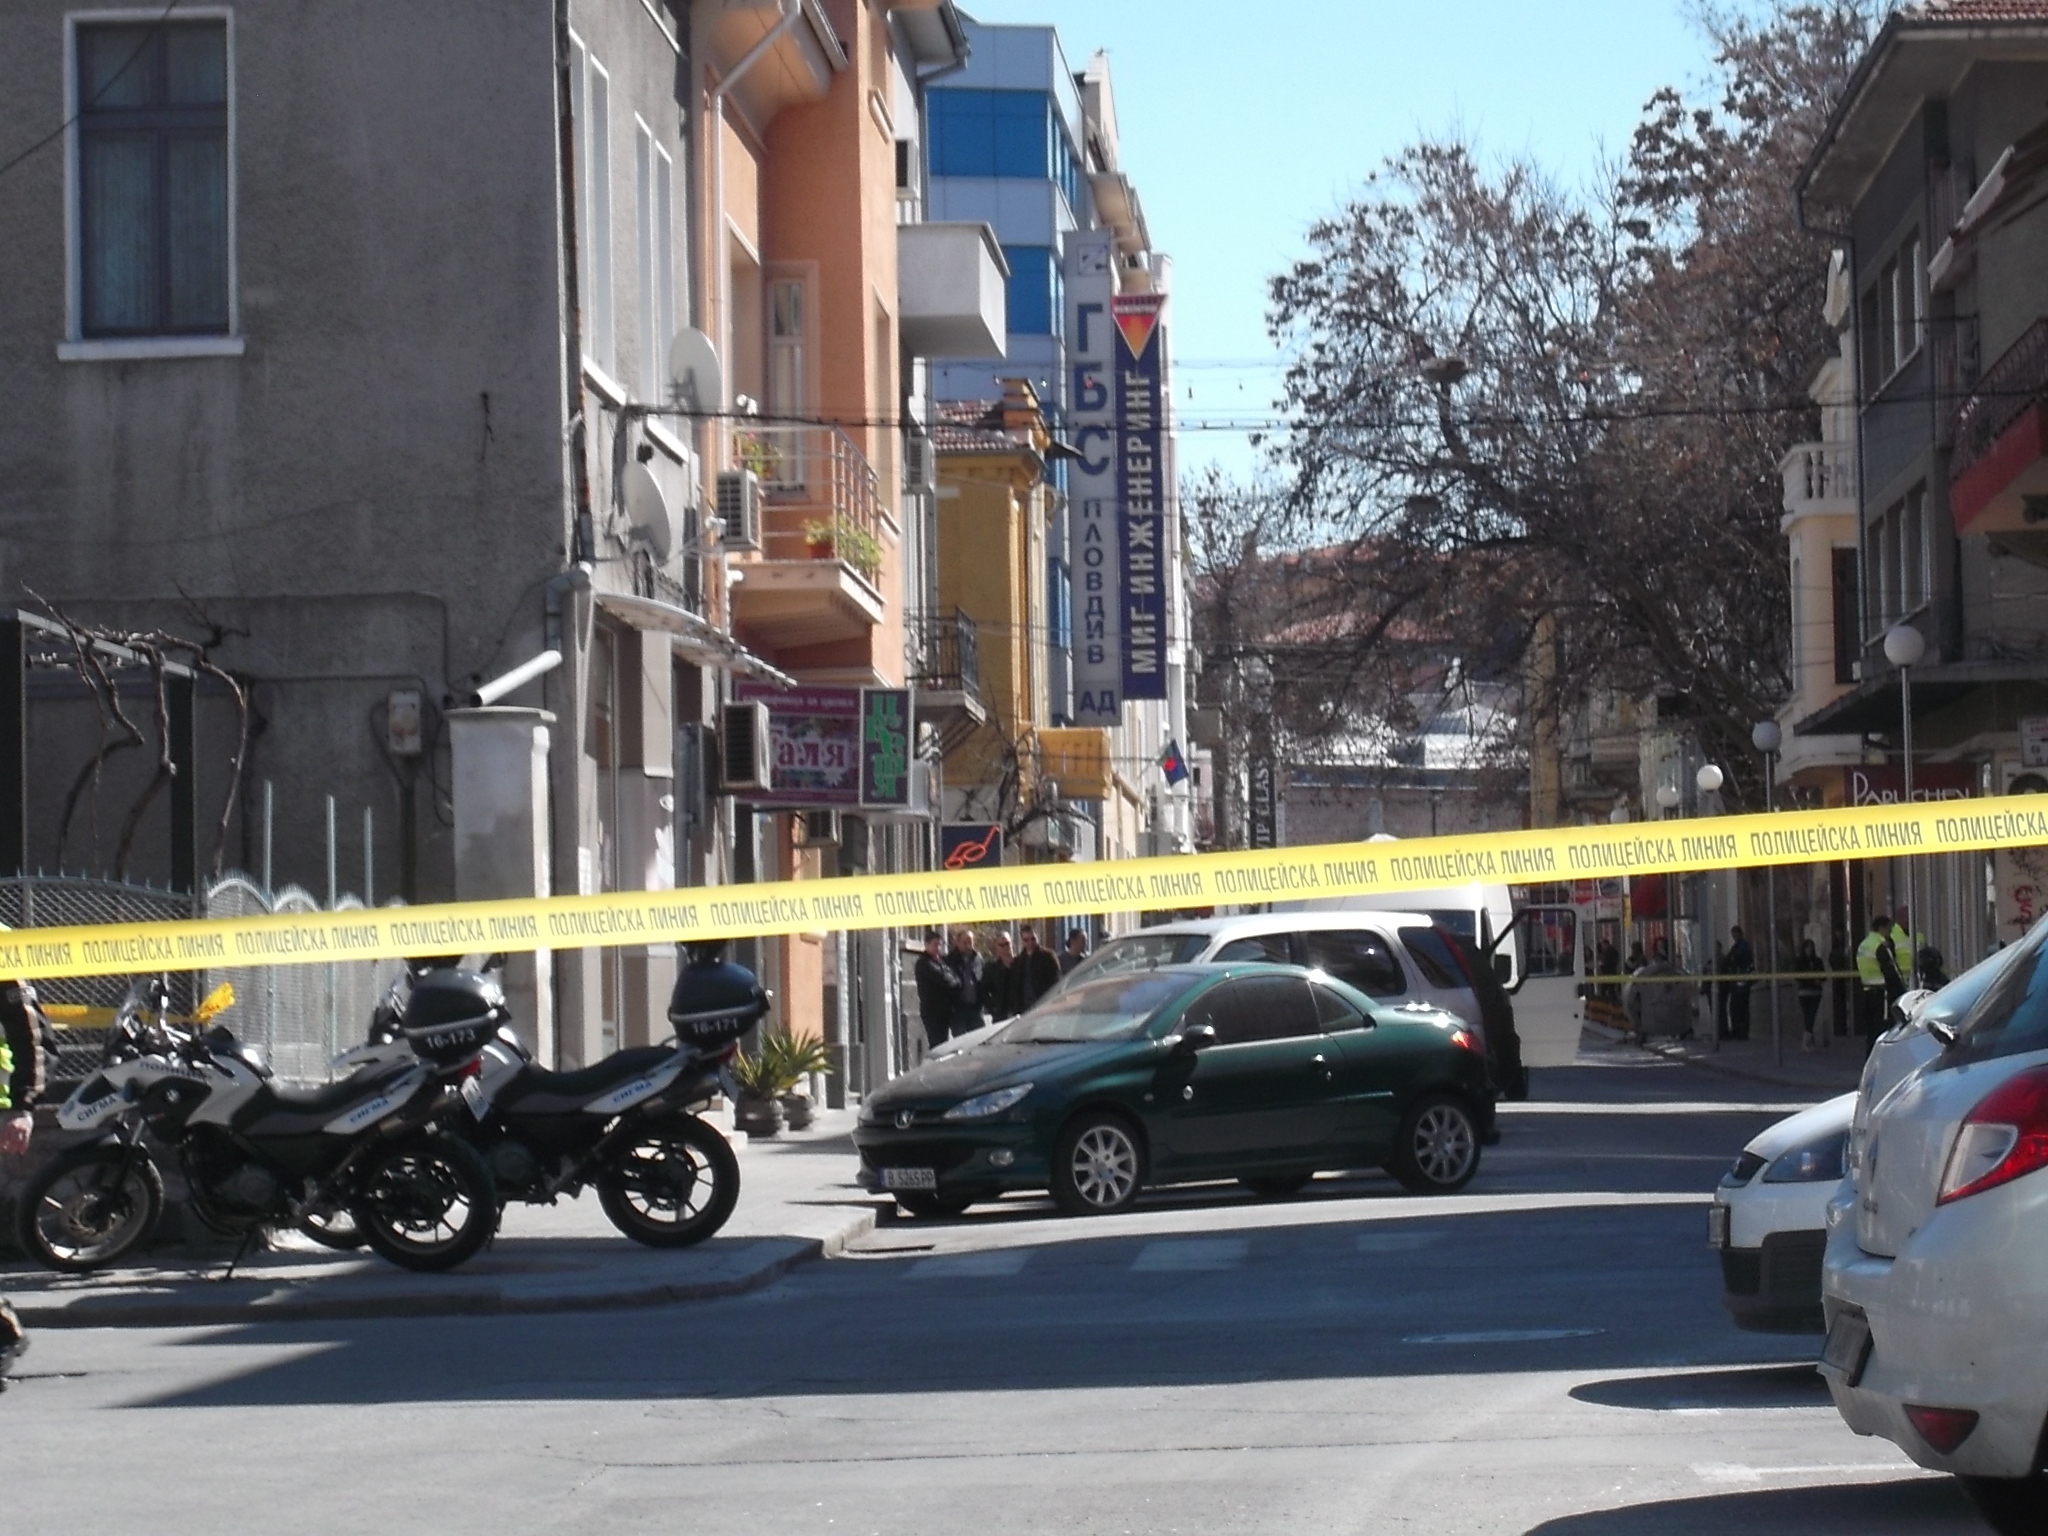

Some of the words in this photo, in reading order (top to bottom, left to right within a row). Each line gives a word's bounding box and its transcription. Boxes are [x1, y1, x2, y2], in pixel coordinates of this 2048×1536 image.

[1074, 303, 1110, 475] ГБС
[1125, 370, 1156, 594] ИНЖЕНЕРИНГ
[1083, 501, 1104, 664] ПЛОВДИВ
[1130, 606, 1157, 673] МИГ
[1080, 691, 1116, 715] АД
[26, 942, 73, 966] ЛИНИЯ
[83, 935, 175, 963] ПОЛИЦЕЙСКА
[177, 934, 225, 957] ЛИНИЯ
[236, 926, 330, 954] ПОЛИЦЕЙСКА
[331, 925, 379, 948] ЛИНИЯ
[390, 917, 485, 945] ПОЛИЦЕЙСКА
[489, 915, 538, 939] ЛИНИЯ
[549, 907, 645, 935] ПОЛИЦЕЙСКА
[649, 905, 699, 929] ЛИНИЯ
[710, 896, 811, 925] ПОЛИЦЕЙСКА
[812, 895, 863, 918] ЛИНИЯ
[875, 885, 976, 915] ПОЛИЦЕЙСКА
[980, 884, 1032, 908] ЛИНИЯ
[1044, 875, 1146, 904] ПОЛИЦЕЙСКА
[1150, 872, 1203, 897] ЛИНИЯ
[1215, 863, 1320, 893] ПОЛИЦЕЙСКА
[1324, 860, 1378, 886] ЛИНИЯ
[1390, 850, 1497, 881] ПОЛИЦЕЙСКА
[1501, 847, 1556, 874] ЛИНИЯ
[1568, 837, 1677, 868] ПОЛИЦЕЙСКА
[1681, 834, 1737, 861] ЛИНИЯ
[1750, 824, 1861, 855] ПОЛИЦЕЙСКА
[1865, 821, 1922, 848] ЛИНИЯ
[1936, 810, 2048, 843] ПОЛИЦЕЙСКА
[427, 1029, 475, 1048] 16-173
